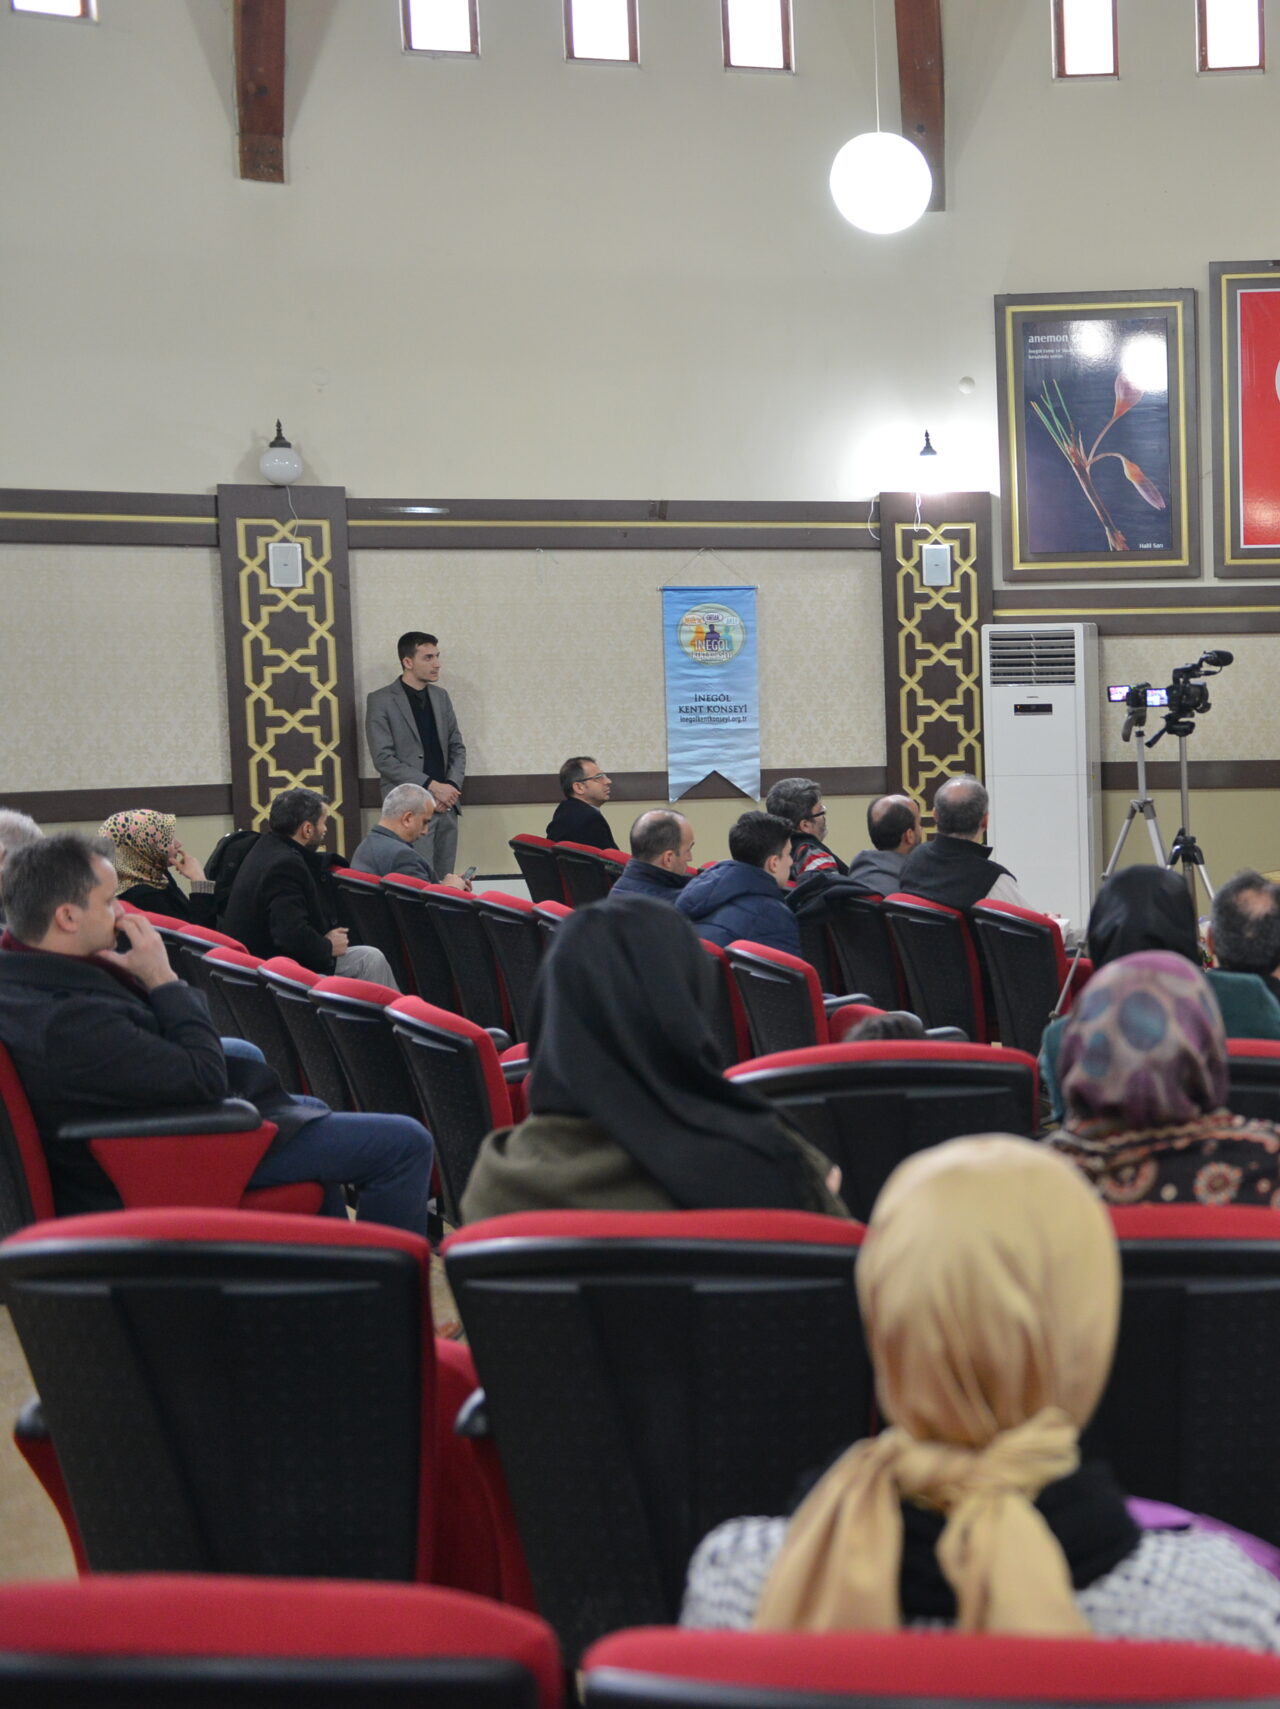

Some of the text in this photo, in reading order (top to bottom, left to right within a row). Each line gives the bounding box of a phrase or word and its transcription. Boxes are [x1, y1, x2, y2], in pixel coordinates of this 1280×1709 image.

[1028, 334, 1068, 343] anemon
[678, 704, 748, 713] KENT KONSEYİ
